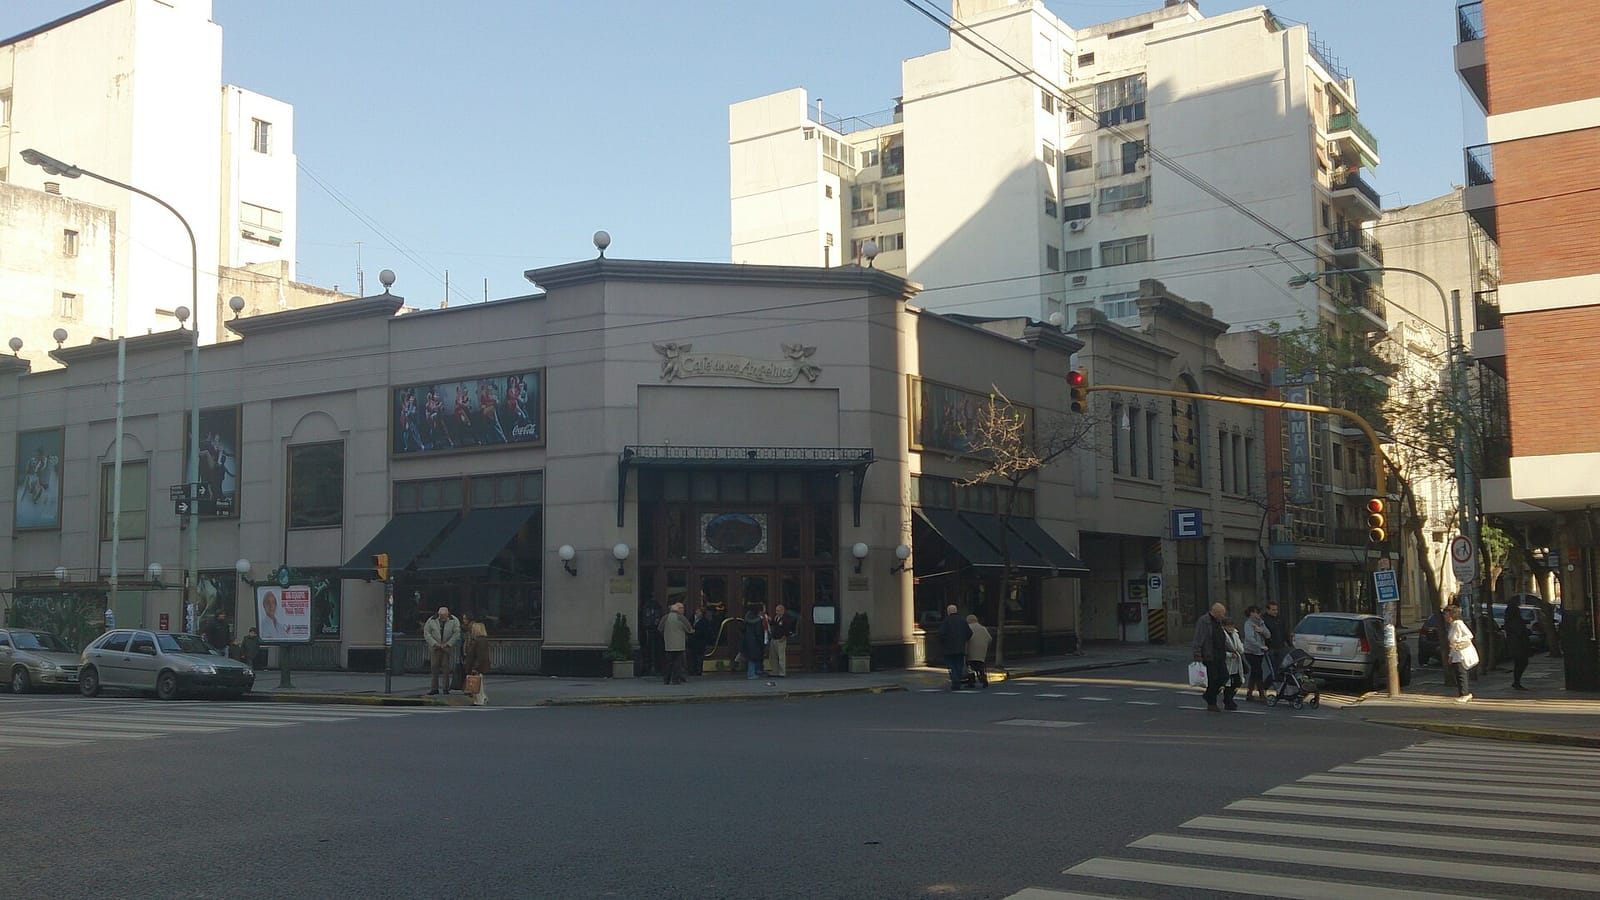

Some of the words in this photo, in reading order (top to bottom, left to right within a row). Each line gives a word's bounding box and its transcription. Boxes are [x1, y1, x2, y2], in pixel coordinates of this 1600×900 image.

[683, 357, 712, 373] Café
[1178, 512, 1197, 536] E
[1151, 576, 1160, 588] E
